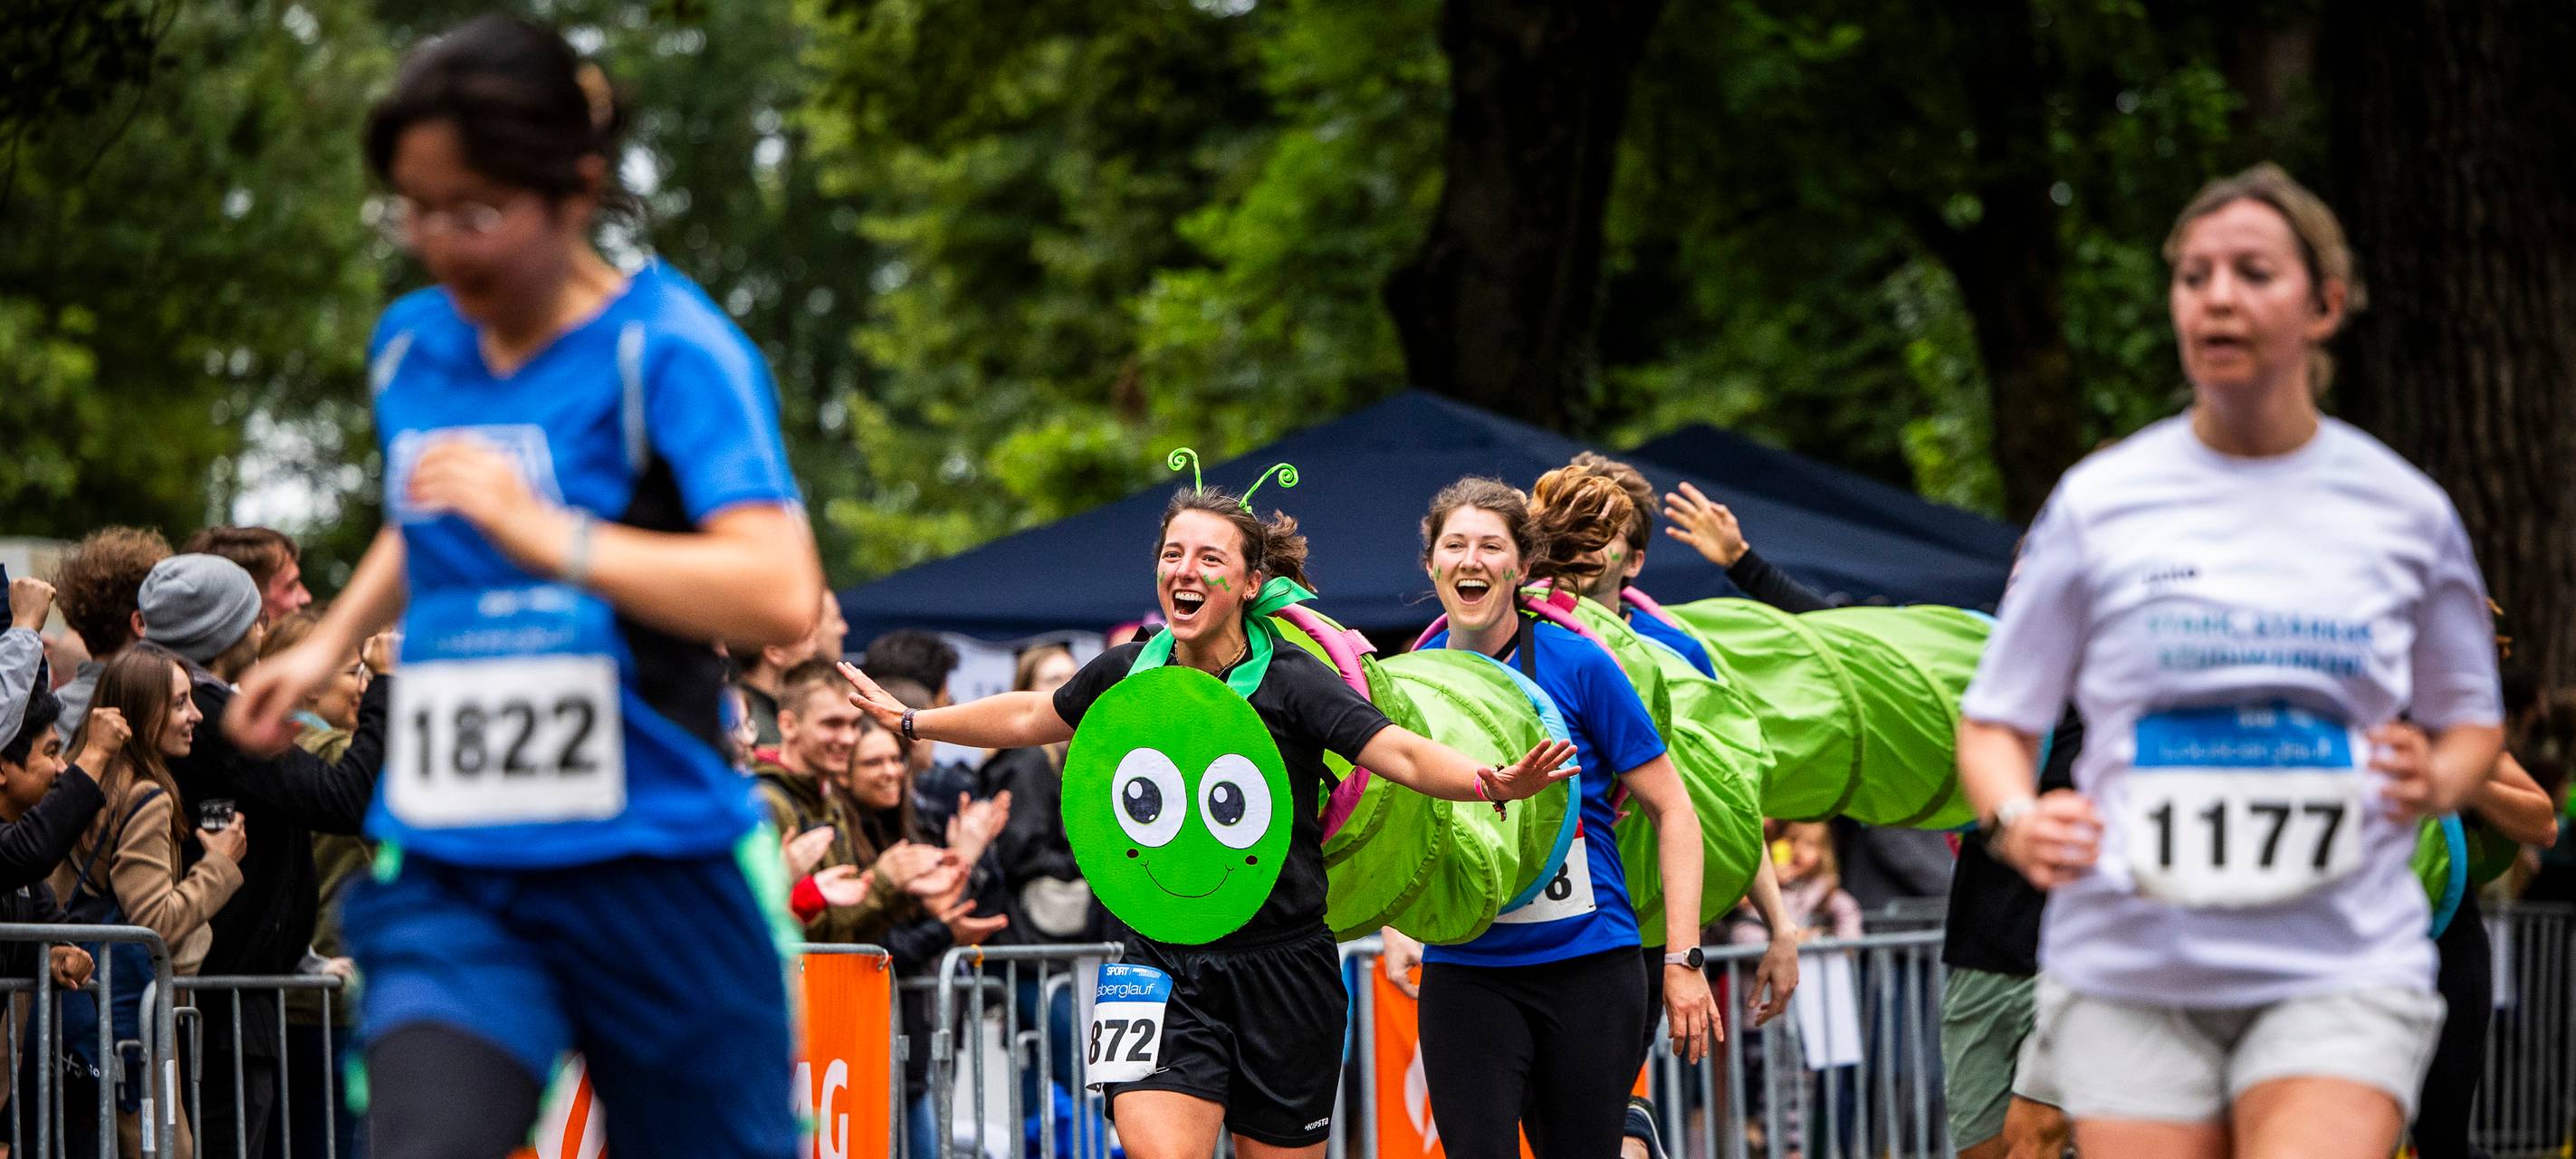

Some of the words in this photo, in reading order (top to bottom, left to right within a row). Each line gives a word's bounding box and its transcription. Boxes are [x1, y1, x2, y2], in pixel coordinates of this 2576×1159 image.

[413, 694, 599, 778] 1822
[2146, 800, 2345, 868] 1177
[1106, 966, 1130, 976] SPORT
[1089, 1019, 1155, 1065] 872
